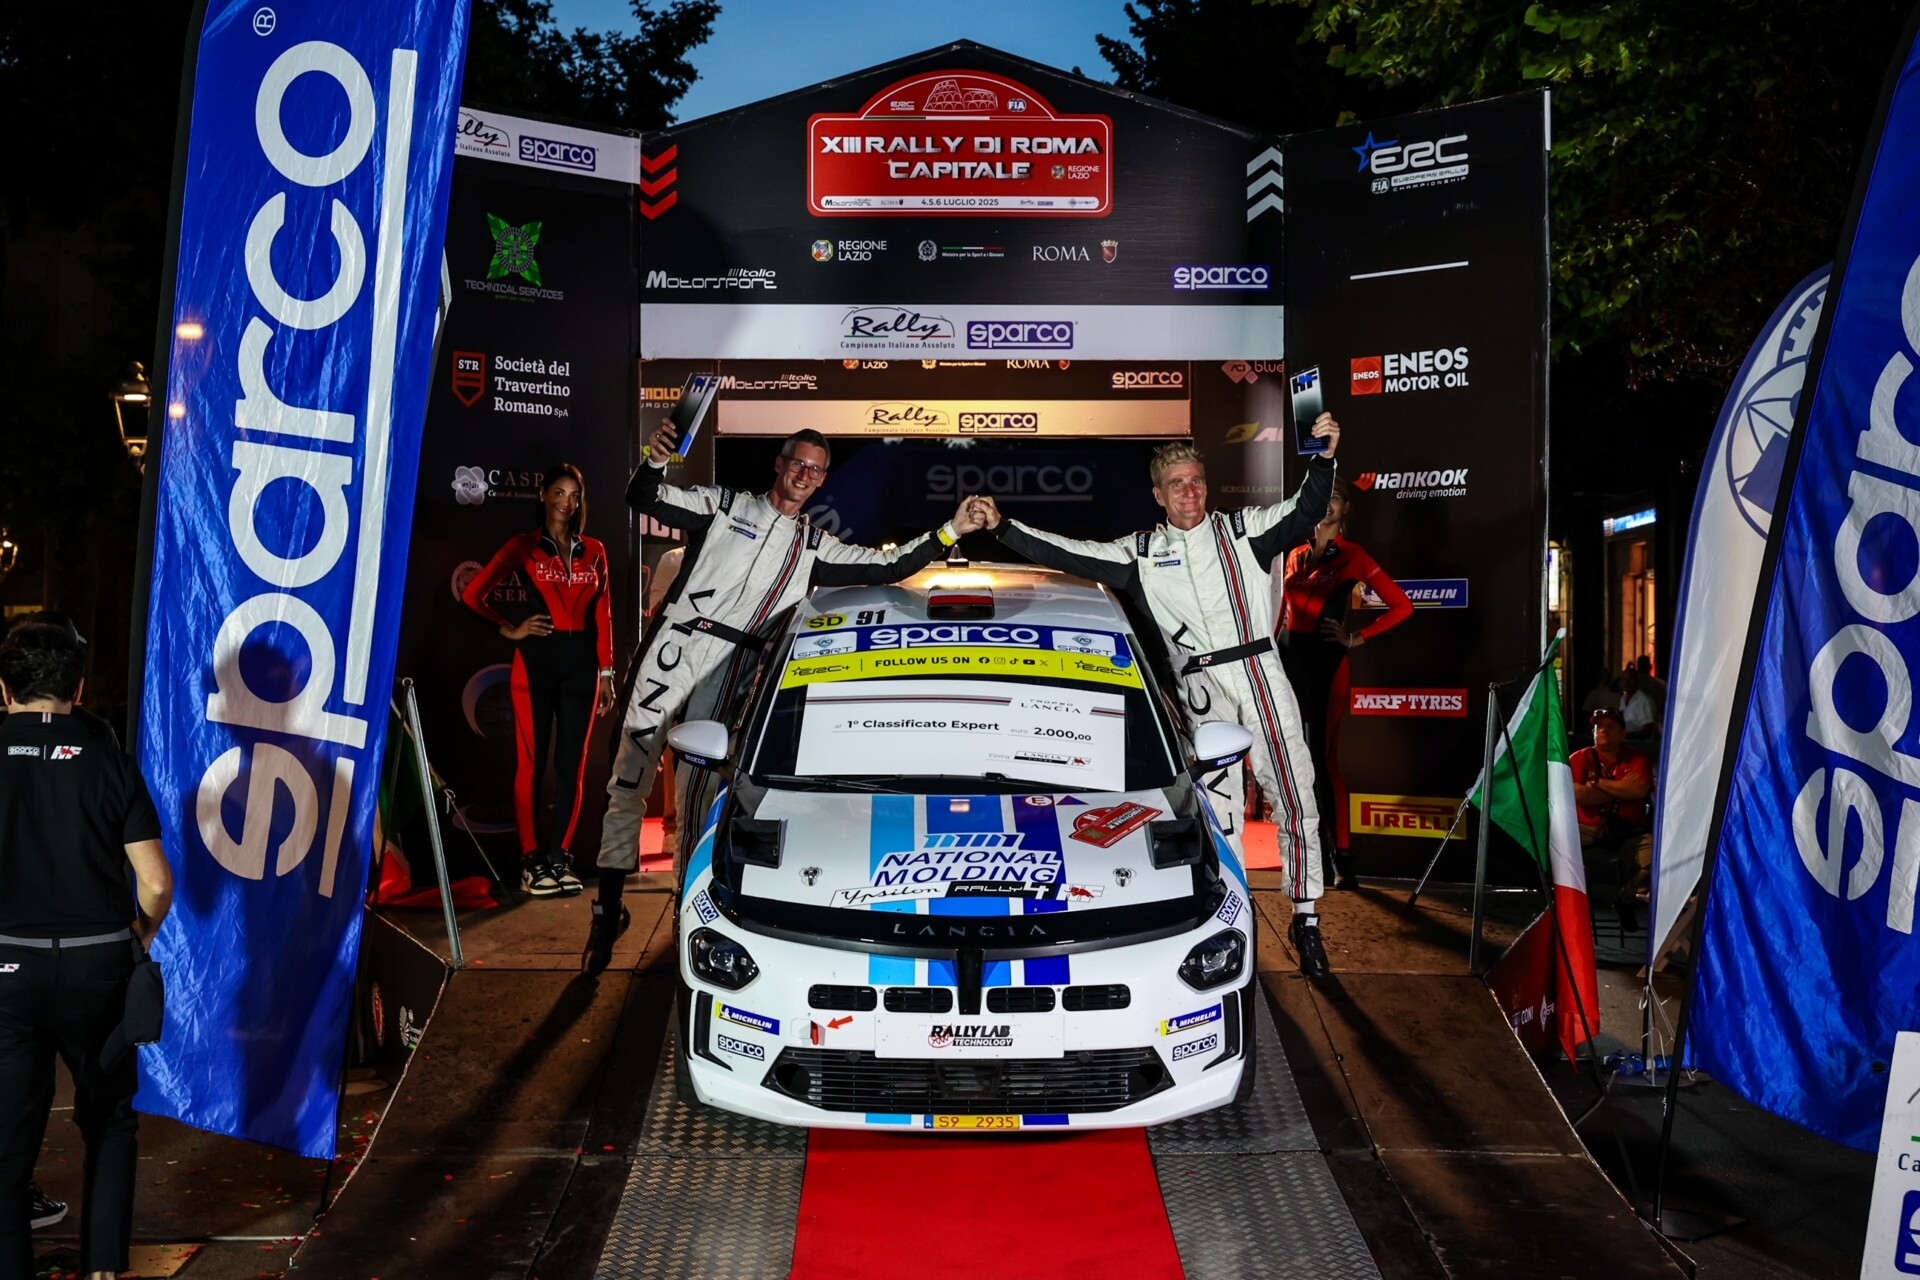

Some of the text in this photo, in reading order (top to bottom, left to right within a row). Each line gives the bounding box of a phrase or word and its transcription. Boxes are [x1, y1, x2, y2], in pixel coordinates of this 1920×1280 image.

[520, 138, 594, 168] sparco
[821, 136, 1100, 154] XIII RALLY DI ROMA
[1370, 134, 1468, 174] ERC
[889, 161, 1031, 179] CAPITALE
[1067, 165, 1100, 173] REGIONE
[1393, 167, 1467, 184] EUROPEAN RALLY
[1371, 178, 1389, 193] FIA
[1392, 176, 1467, 192] CHAMPIONSHIP
[921, 198, 999, 206] 4.5.6 LUGLIO 2025
[838, 240, 888, 251] REGIONE
[1032, 246, 1091, 261] ROMA
[838, 251, 872, 261] LAZIO
[645, 269, 778, 289] Motorsport
[739, 268, 777, 278] Italia
[1173, 266, 1269, 290] sparco
[464, 279, 518, 295] TECHNICAL
[518, 286, 564, 301] SERVICES
[851, 313, 942, 341] Rally
[969, 323, 1071, 349] sparco
[840, 341, 956, 351] Campionato Italiano Assoluto
[458, 359, 480, 371] STR
[494, 356, 570, 377] Società del
[862, 360, 889, 369] LAZIO
[1006, 359, 1051, 369] ROMA
[1384, 347, 1469, 376] ENEOS
[719, 376, 818, 390] Motorsport
[1112, 370, 1183, 390] sparco
[1353, 371, 1379, 380] ENEOS
[1384, 372, 1469, 393] MOTOR OIL
[494, 376, 571, 397] Travertino
[493, 397, 569, 418] Romano SpA
[873, 406, 940, 426] Rally
[959, 413, 1037, 433] sparco
[195, 40, 378, 880] sparco
[926, 464, 1094, 501] sparco
[1396, 486, 1467, 500] driving emotion
[1793, 253, 1920, 900] spar
[1403, 588, 1457, 600] CHELIN
[809, 615, 844, 629] SD
[855, 609, 886, 625] 91
[870, 626, 1040, 649] sparco
[797, 646, 852, 658] SPORT
[1057, 644, 1112, 657] SPORT
[875, 656, 970, 667] FOLLOW US ON
[1020, 702, 1081, 714] LANCIA
[1353, 693, 1463, 711] MRF TYRES
[862, 719, 947, 729] Classificato
[951, 720, 1000, 731] Expert
[1033, 727, 1092, 741] 2.000,00
[988, 752, 1011, 760] Firma
[1360, 801, 1456, 831] PIRELLI
[882, 851, 1058, 868] NATIONAL
[874, 866, 1055, 887] MOLDING
[841, 886, 941, 904] Ypsilon
[1023, 881, 1049, 900] 4
[695, 892, 717, 924] sparco
[1219, 891, 1241, 924] sparco
[893, 923, 1046, 937] LANCIA
[731, 1012, 773, 1029] MICHELIN
[1179, 1009, 1217, 1027] MICHELIN
[718, 1035, 764, 1059] sparco
[954, 1038, 1012, 1046] TECHNOLOGY
[1173, 1035, 1217, 1060] sparco
[939, 1116, 960, 1128] S9
[975, 1116, 1014, 1128] 2935
